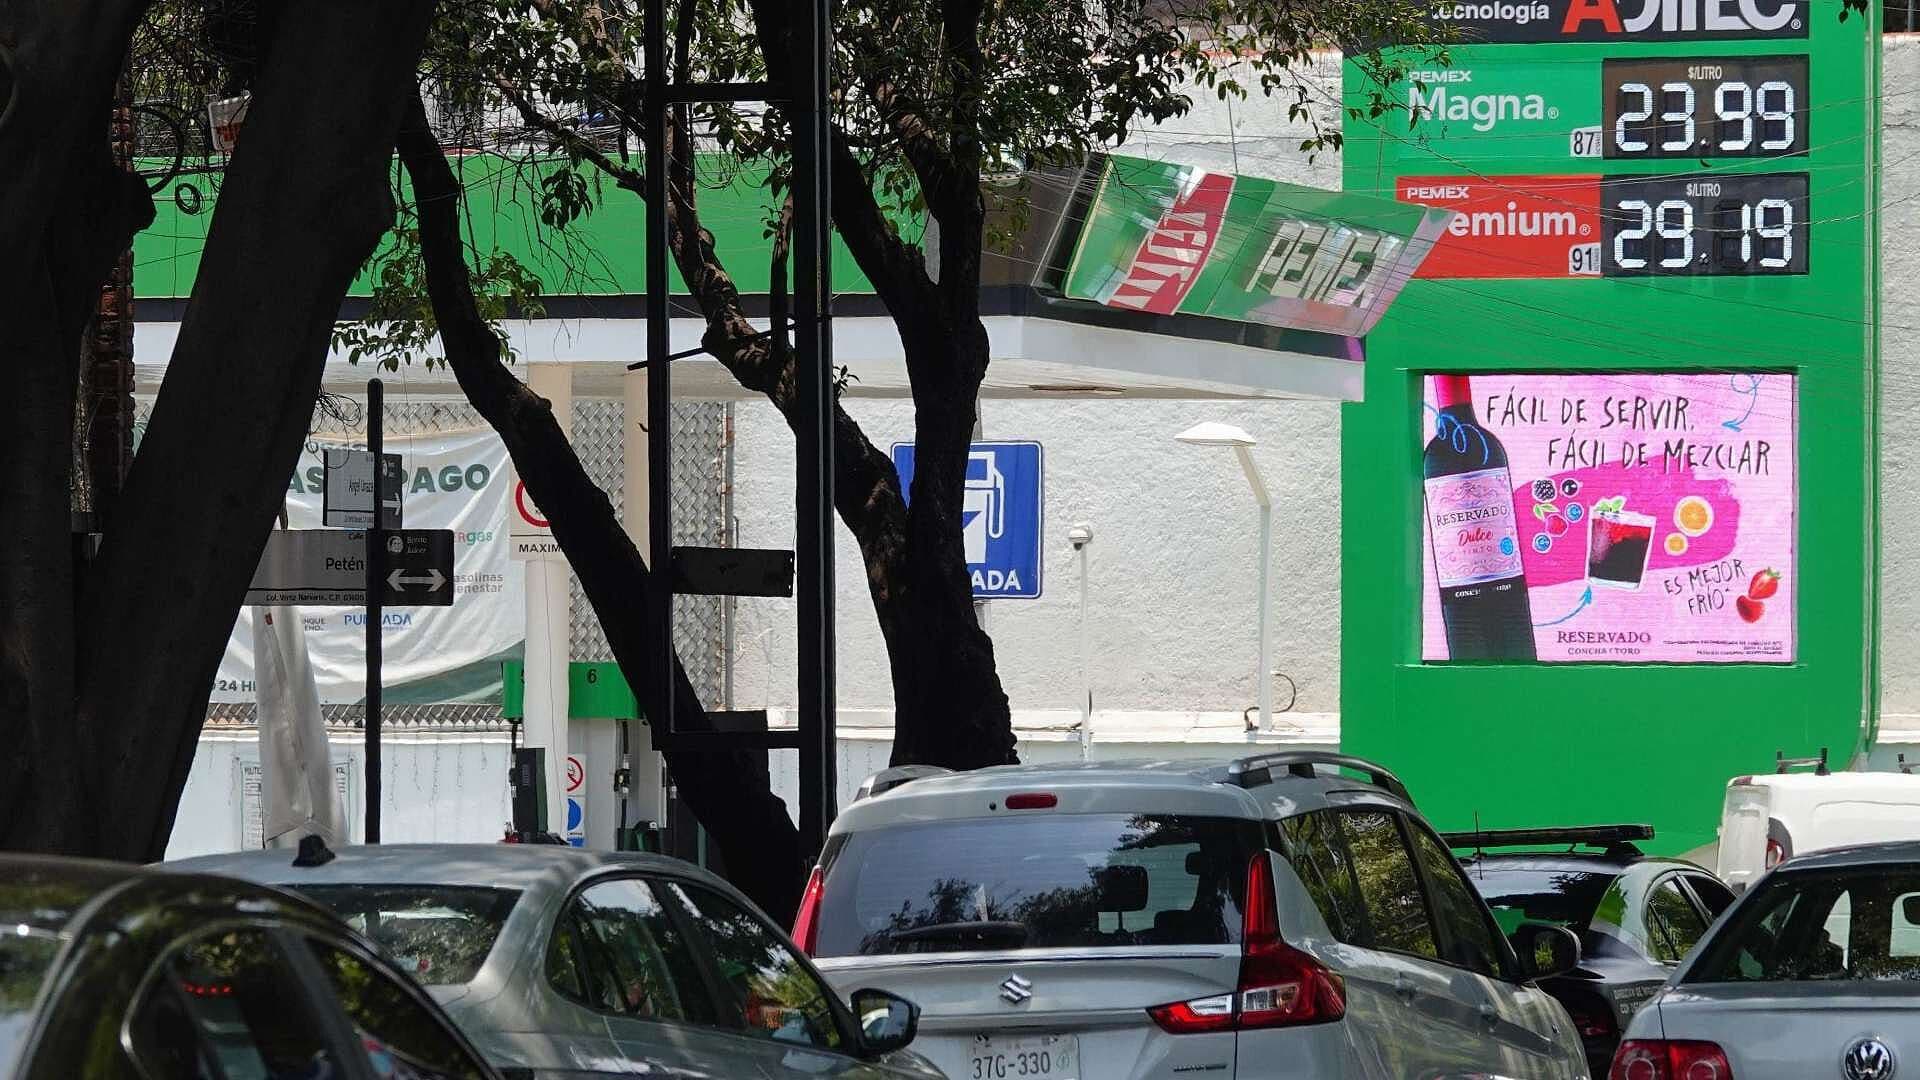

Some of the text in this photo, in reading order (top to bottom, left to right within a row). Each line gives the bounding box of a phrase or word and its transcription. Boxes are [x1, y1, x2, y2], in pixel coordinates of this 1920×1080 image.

[1431, 1, 1549, 24] ecnología
[1409, 70, 1472, 83] PEMEX
[1688, 65, 1722, 80] $/LITRO
[1408, 86, 1544, 131] Magna
[1615, 81, 1795, 152] 23.99
[1573, 130, 1595, 155] 87
[1406, 187, 1469, 199] PEMEX
[1686, 183, 1720, 197] $/LITRO
[1448, 203, 1577, 237] emium
[1614, 198, 1793, 269] 29.19
[1571, 247, 1593, 271] 91
[1486, 386, 1548, 427] FÁCIL
[1560, 397, 1588, 426] DE
[1548, 429, 1771, 476] FÁCIL DE MEZCLAR
[401, 463, 490, 493] AGO
[1436, 505, 1508, 527] RESERVADO
[1457, 527, 1494, 547] Dulce
[518, 544, 562, 553] MAXIM
[325, 556, 365, 572] Petén
[453, 571, 504, 583] asolinas
[971, 569, 1022, 591] ADA
[1664, 559, 1747, 596] ES MEJOR
[344, 614, 412, 625] PUADA
[1557, 631, 1651, 644] RESERVADO
[220, 680, 237, 692] 24
[587, 668, 597, 684] 6
[972, 1051, 1051, 1079] 37G-330
